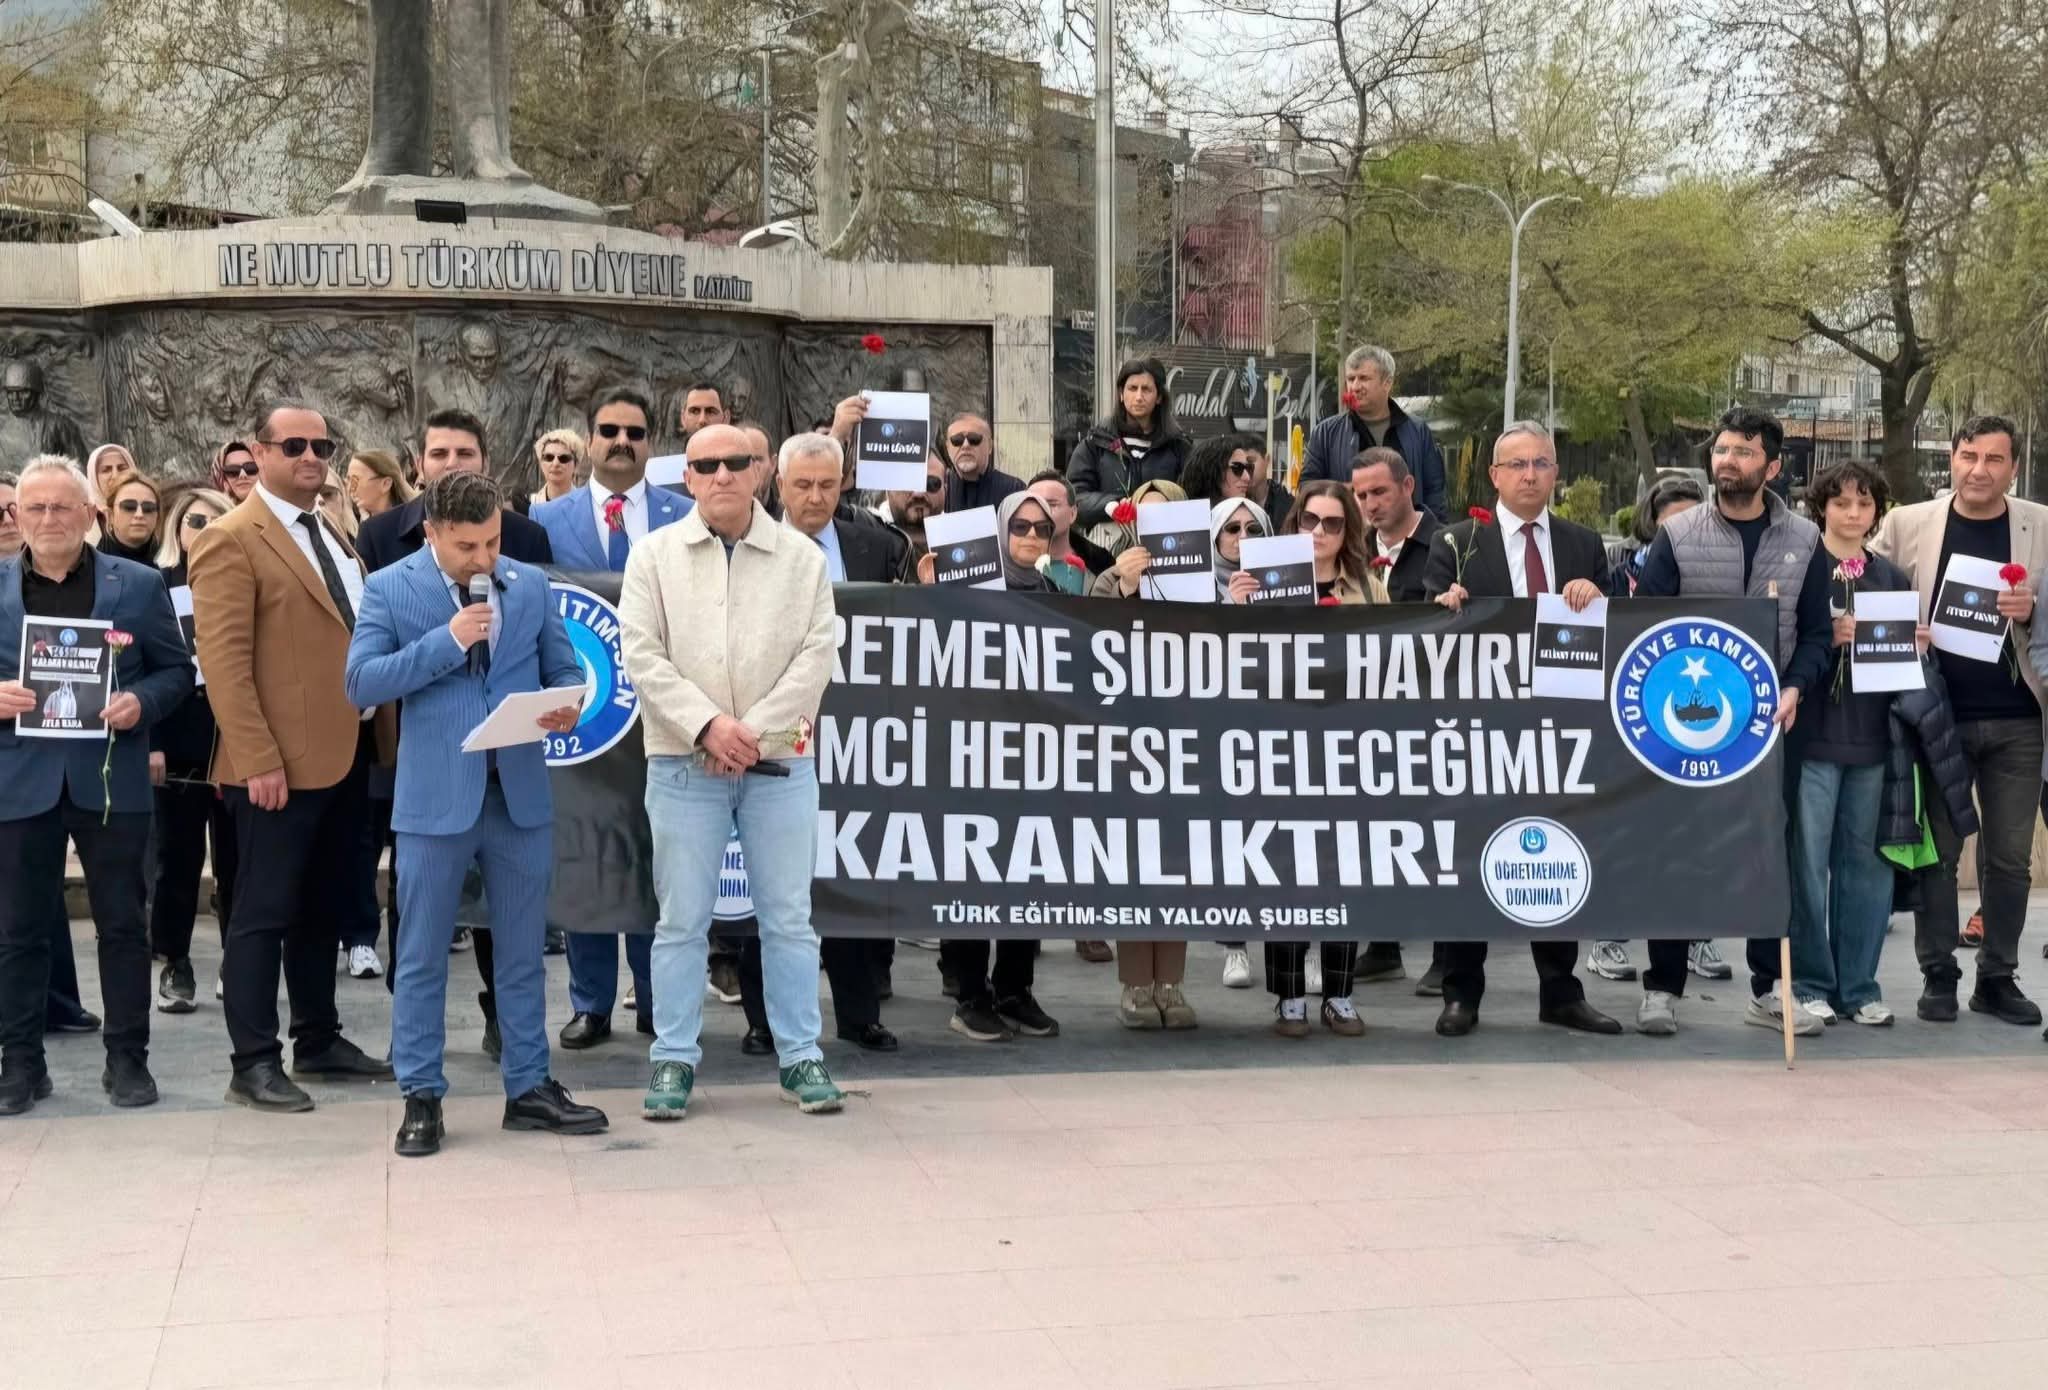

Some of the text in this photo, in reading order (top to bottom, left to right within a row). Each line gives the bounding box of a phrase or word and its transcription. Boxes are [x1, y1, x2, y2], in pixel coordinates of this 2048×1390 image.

[218, 244, 258, 287] NE
[264, 243, 392, 287] MUTLU
[401, 238, 561, 292] TÜRKÜM
[572, 241, 687, 298] DİYENE
[1090, 619, 1325, 706] ŞİDDETE
[1345, 632, 1532, 700] HAYIR!
[1621, 627, 1773, 741] TÜRKİYE KAMU-SEN
[818, 706, 1596, 797] MCİ HEDEFSE GELECEĞİMİZ
[1680, 758, 1721, 777] 1992
[813, 810, 1459, 886] KARANLIKTIR!
[932, 900, 1348, 931] TÜRK EĞİTİM-SEN YALOVA ŞUBESİ
